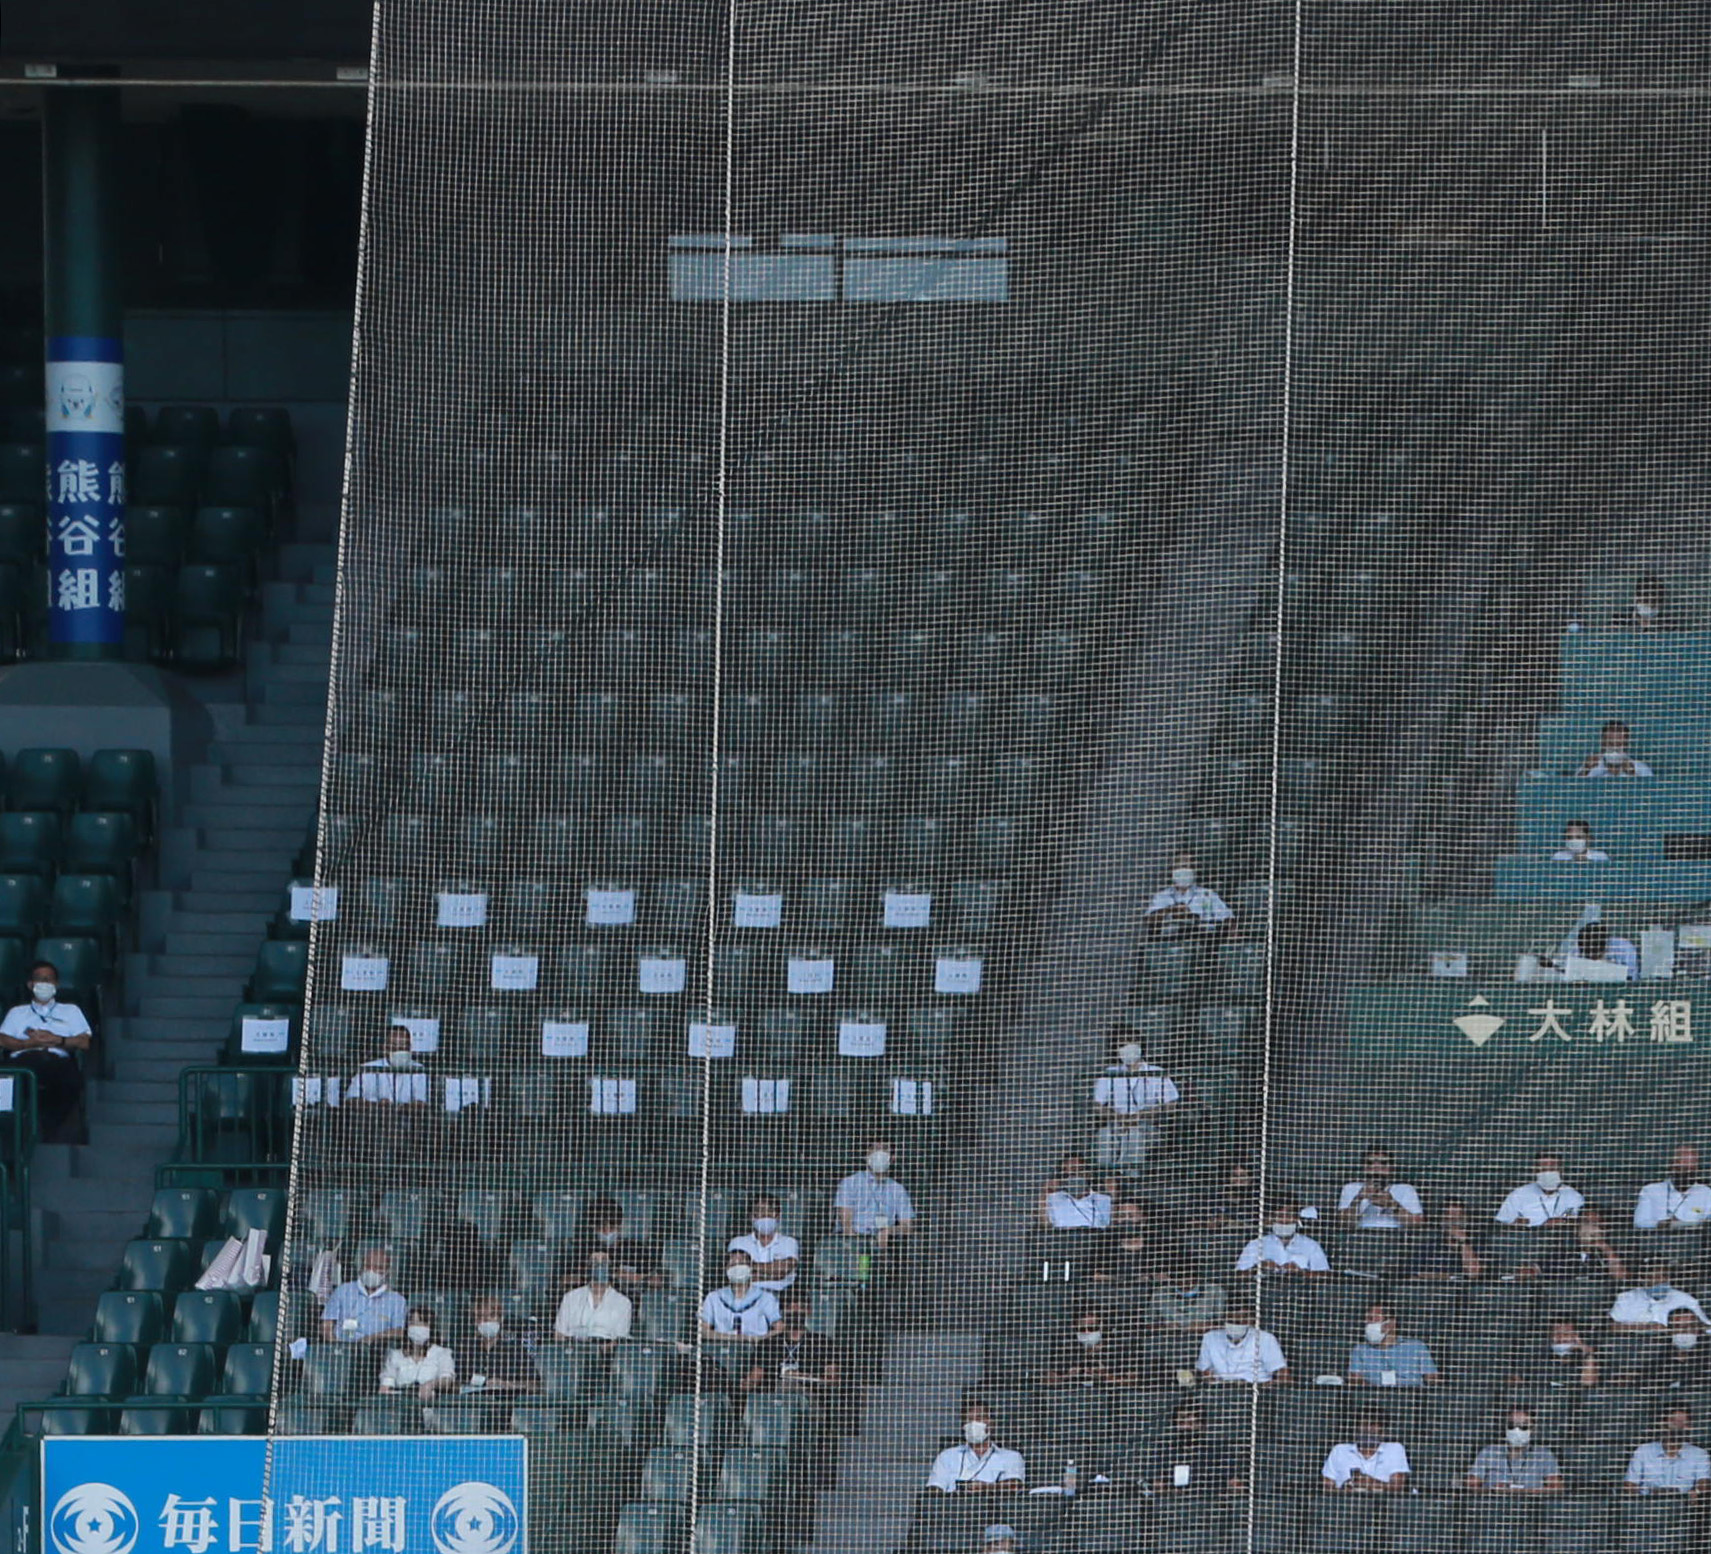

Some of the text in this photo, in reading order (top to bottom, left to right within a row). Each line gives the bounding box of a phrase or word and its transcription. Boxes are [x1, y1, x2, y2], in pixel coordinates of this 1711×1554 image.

[57, 459, 101, 611] 熊谷組
[1527, 1000, 1693, 1044] 大林組
[158, 1492, 407, 1554] 毎日新聞
